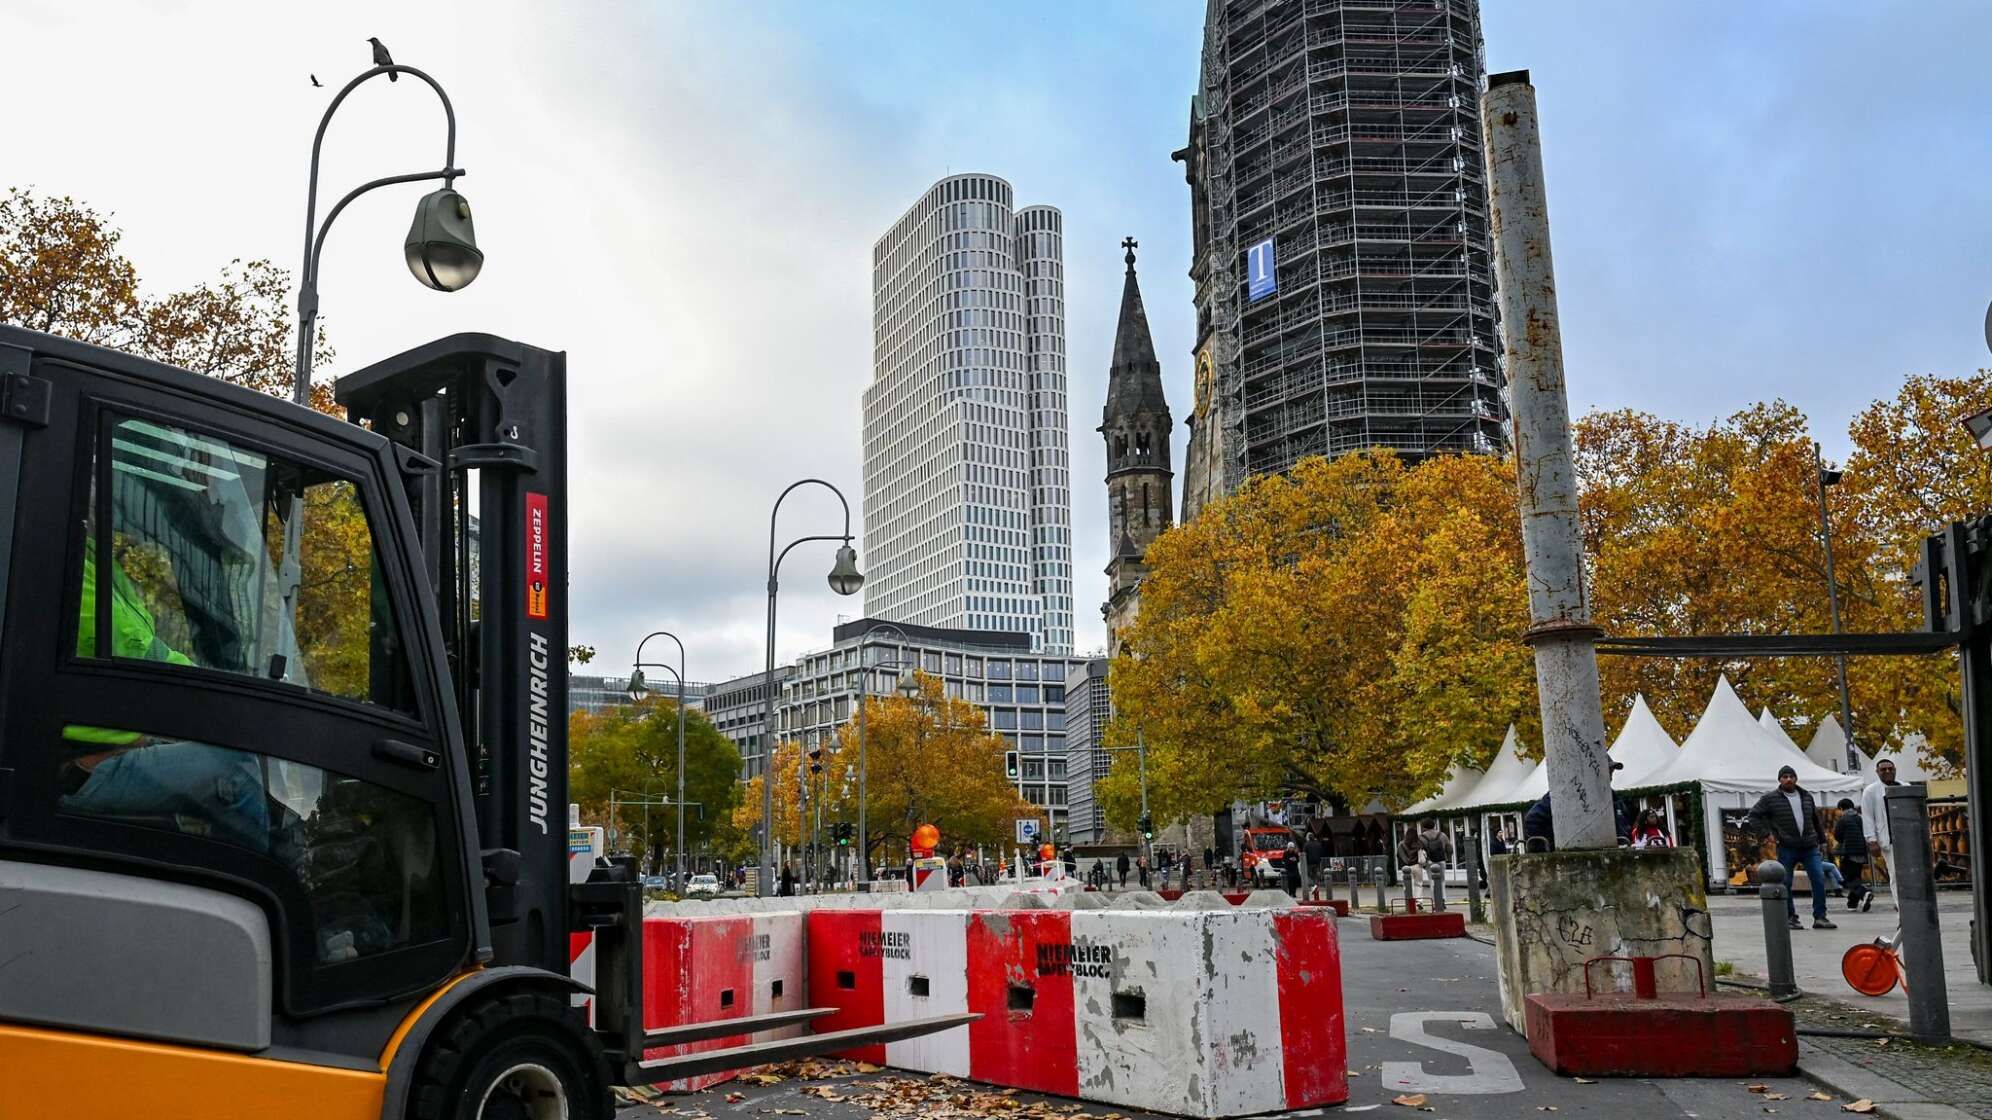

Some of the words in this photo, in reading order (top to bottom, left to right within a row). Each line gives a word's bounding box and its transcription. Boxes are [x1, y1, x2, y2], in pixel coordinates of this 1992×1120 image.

[1249, 238, 1273, 282] T
[532, 508, 542, 574] ZEPPELIN
[529, 631, 548, 835] JUNGHEINRICH
[859, 931, 911, 947] NIEMEIER
[1036, 943, 1111, 963] NIEMEIER
[1382, 1011, 1526, 1094] S
